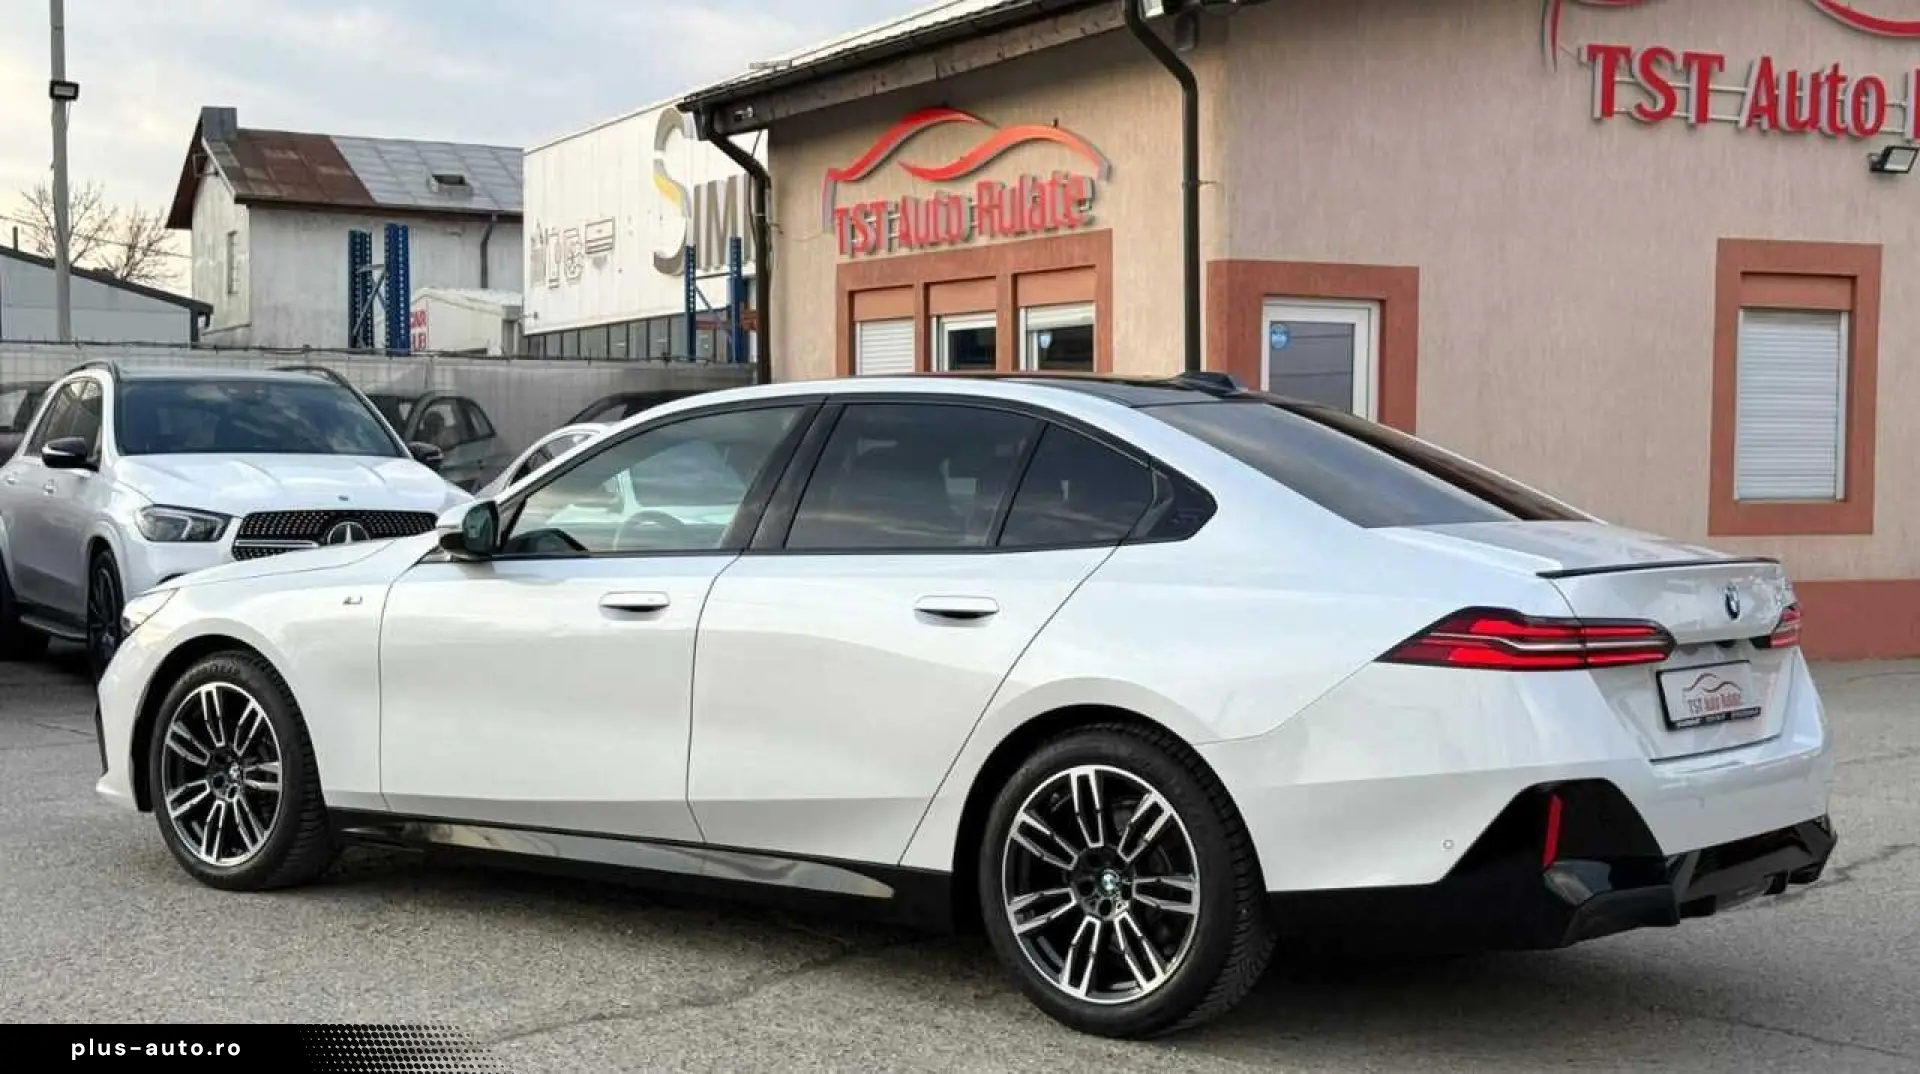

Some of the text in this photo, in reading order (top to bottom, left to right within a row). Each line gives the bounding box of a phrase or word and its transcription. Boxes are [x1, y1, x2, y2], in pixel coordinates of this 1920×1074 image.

[1586, 44, 1725, 124] TST
[1740, 55, 1886, 138] Auto
[834, 171, 1092, 256] TST Auto Rulate
